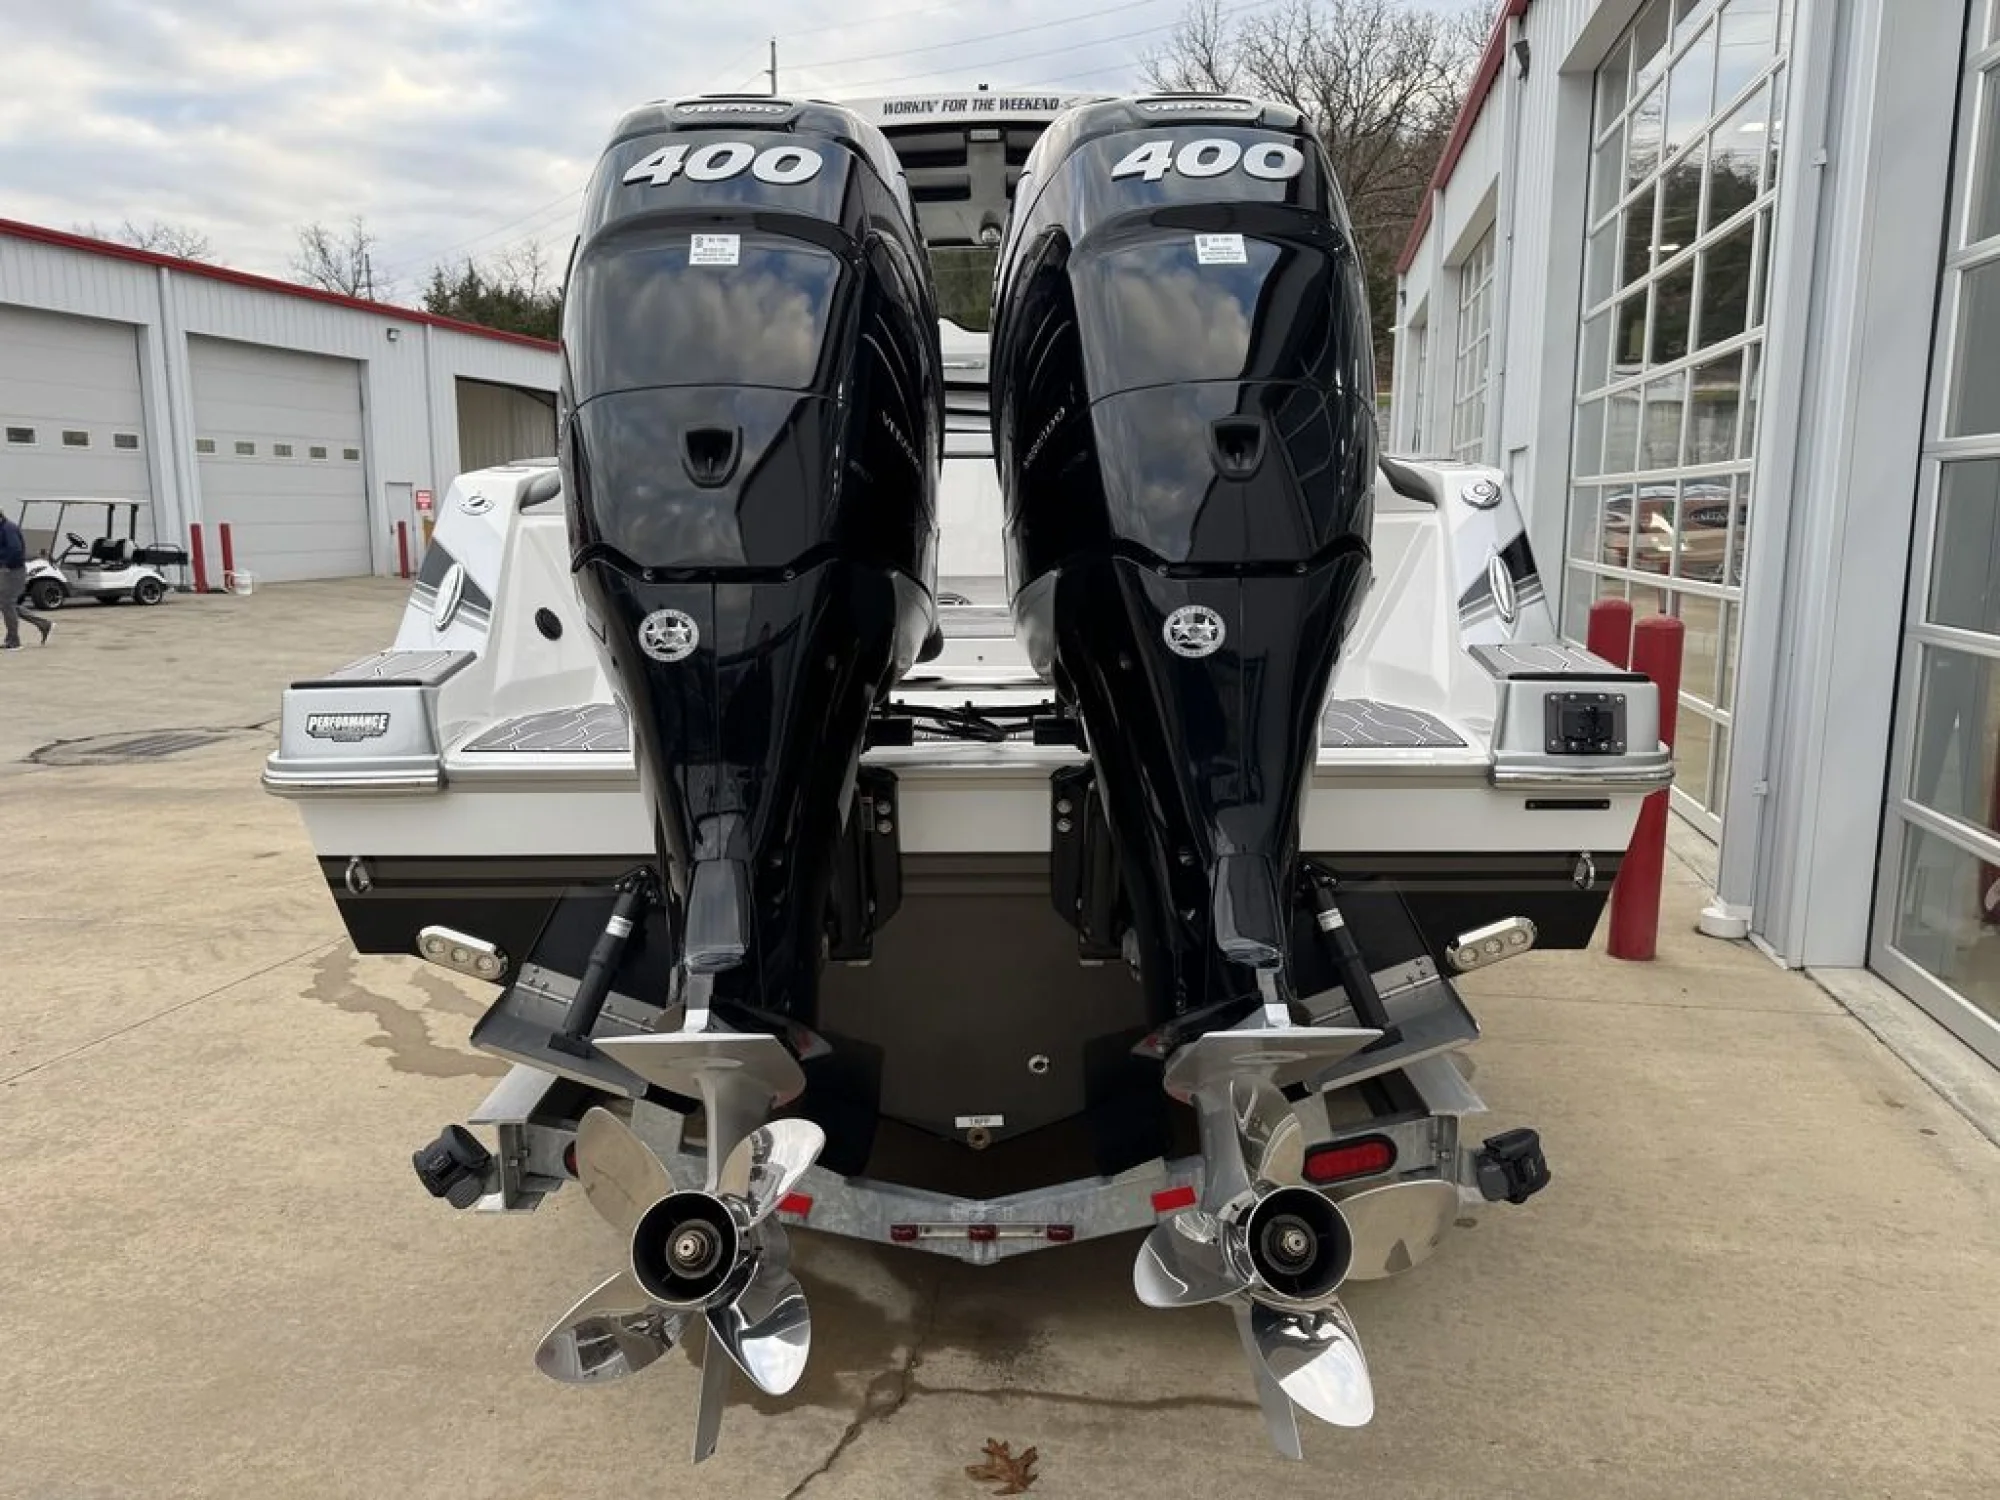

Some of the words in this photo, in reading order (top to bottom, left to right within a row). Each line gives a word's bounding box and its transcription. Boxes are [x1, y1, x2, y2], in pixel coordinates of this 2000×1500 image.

[884, 101, 938, 115] WORKIN'
[941, 99, 968, 112] FOR
[971, 98, 996, 111] THE
[1000, 97, 1060, 111] WEEKEND
[622, 142, 823, 188] 400
[1111, 139, 1304, 183] 400
[307, 714, 388, 731] PERFORMANCE
